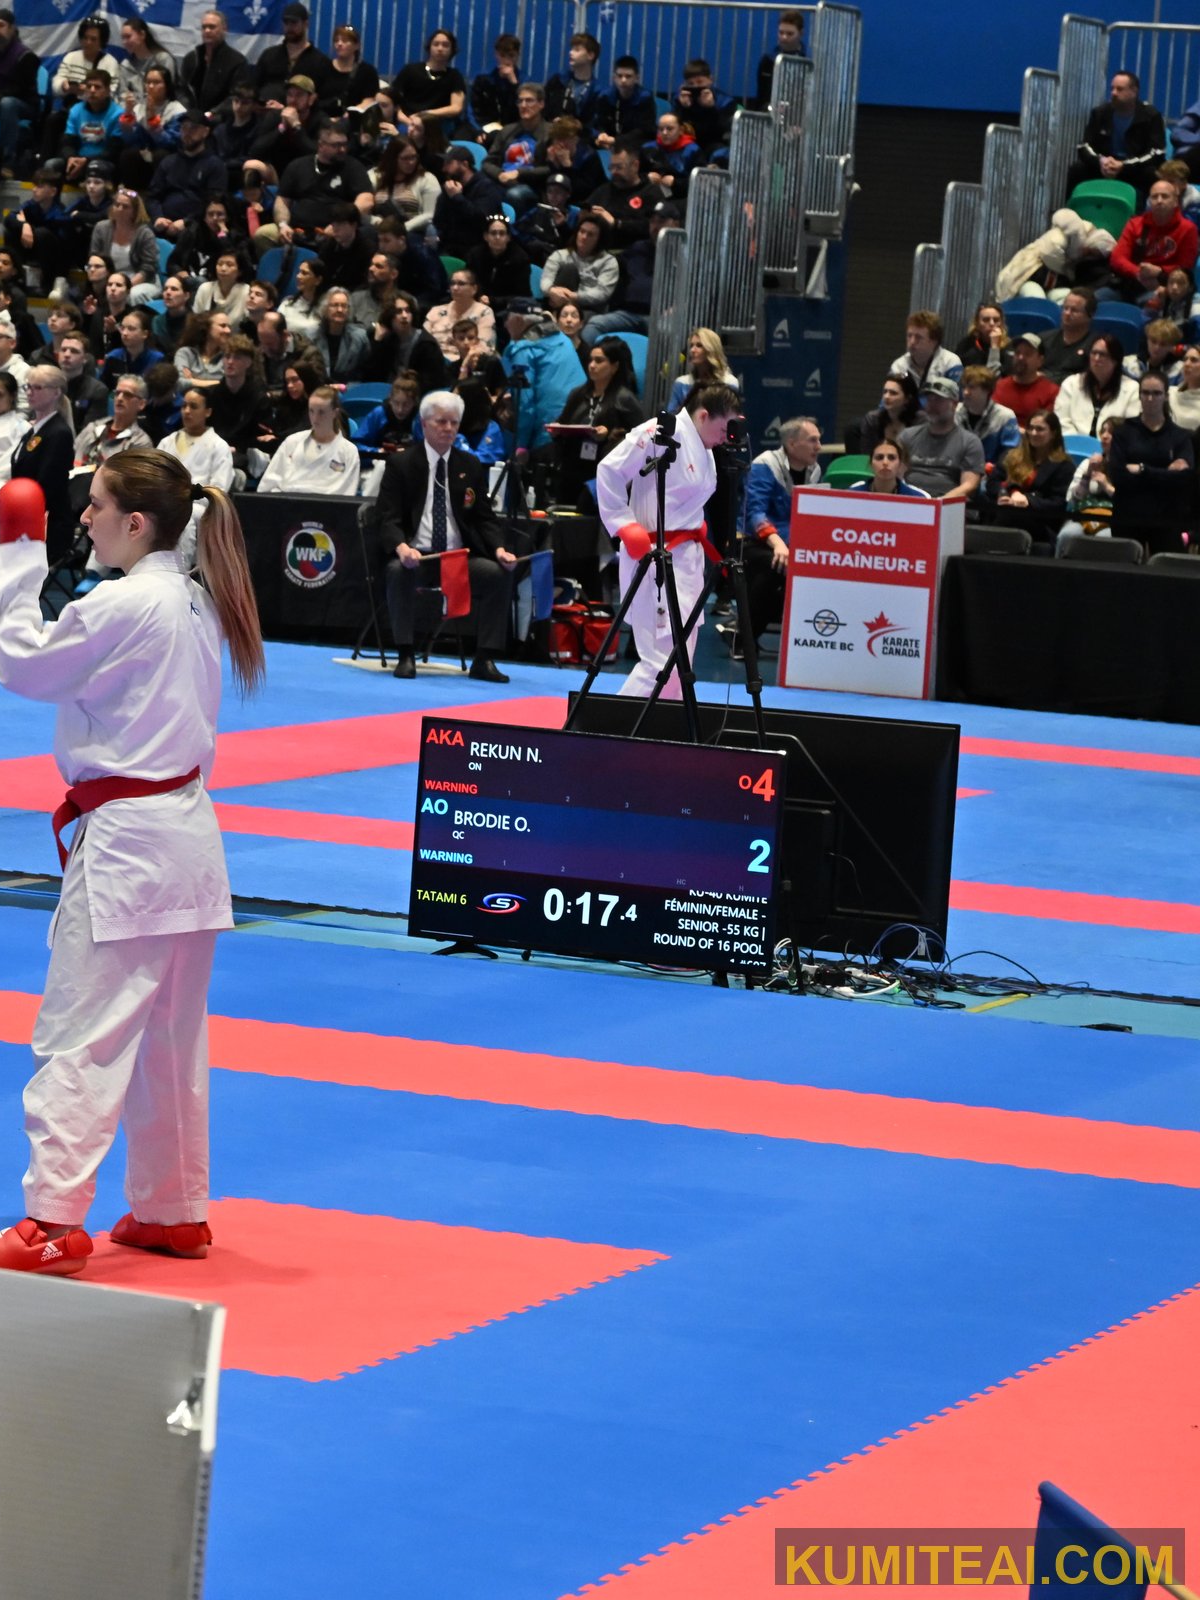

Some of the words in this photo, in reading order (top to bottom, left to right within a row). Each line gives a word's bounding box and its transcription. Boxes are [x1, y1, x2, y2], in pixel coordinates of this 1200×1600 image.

[831, 528, 897, 547] COACH
[296, 547, 327, 562] WKF
[794, 638, 837, 650] KARATE
[840, 642, 855, 652] BC
[882, 636, 920, 648] KARATE
[881, 646, 920, 659] CANADA
[426, 728, 465, 747] AKA
[470, 741, 522, 761] REKUN
[526, 748, 542, 763] N.
[468, 762, 482, 771] ON
[424, 780, 478, 794] WARNING
[421, 797, 448, 815] AO
[454, 810, 510, 830] BRODIE
[514, 816, 530, 832] O.
[452, 830, 465, 839] QC
[419, 849, 473, 864] WARNING
[747, 839, 771, 874] 2
[416, 889, 457, 904] TATAMI
[460, 894, 467, 905] 6
[664, 898, 758, 920] FÉMININ/FEMALE
[678, 918, 719, 933] SENIOR
[722, 924, 740, 936] -55
[743, 925, 759, 938] KG
[653, 932, 695, 948] ROUND
[698, 938, 714, 950] OF
[718, 940, 730, 951] 16
[733, 942, 764, 955] POOL
[41, 1251, 63, 1262] adidas
